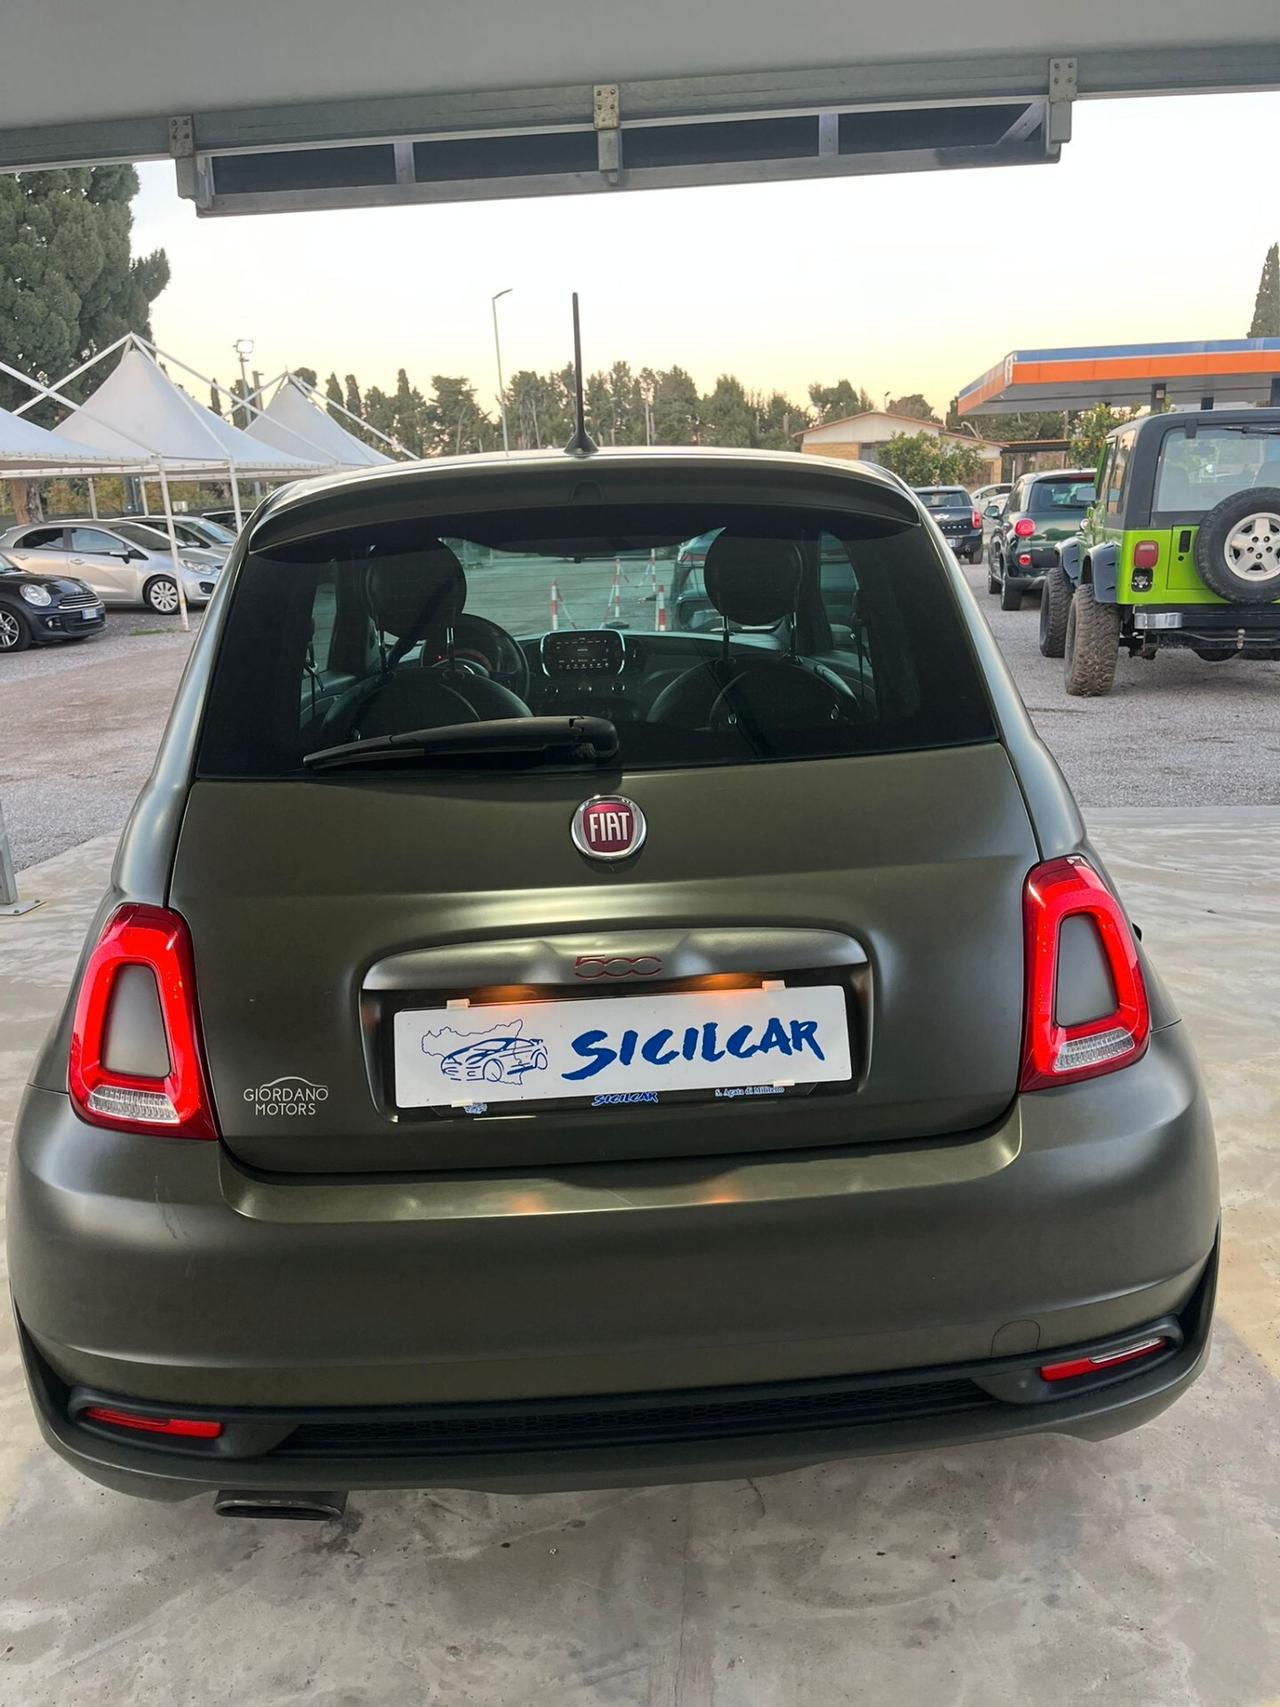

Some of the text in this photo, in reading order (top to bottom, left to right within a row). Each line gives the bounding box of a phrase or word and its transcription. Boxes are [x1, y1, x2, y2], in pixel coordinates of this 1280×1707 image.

[589, 812, 630, 842] FIAT
[574, 954, 662, 980] 500
[561, 1017, 825, 1081] SICILCAR
[243, 1088, 328, 1101] GIORDANO
[591, 1092, 659, 1106] SICILCAR
[255, 1103, 316, 1115] MOTORS
